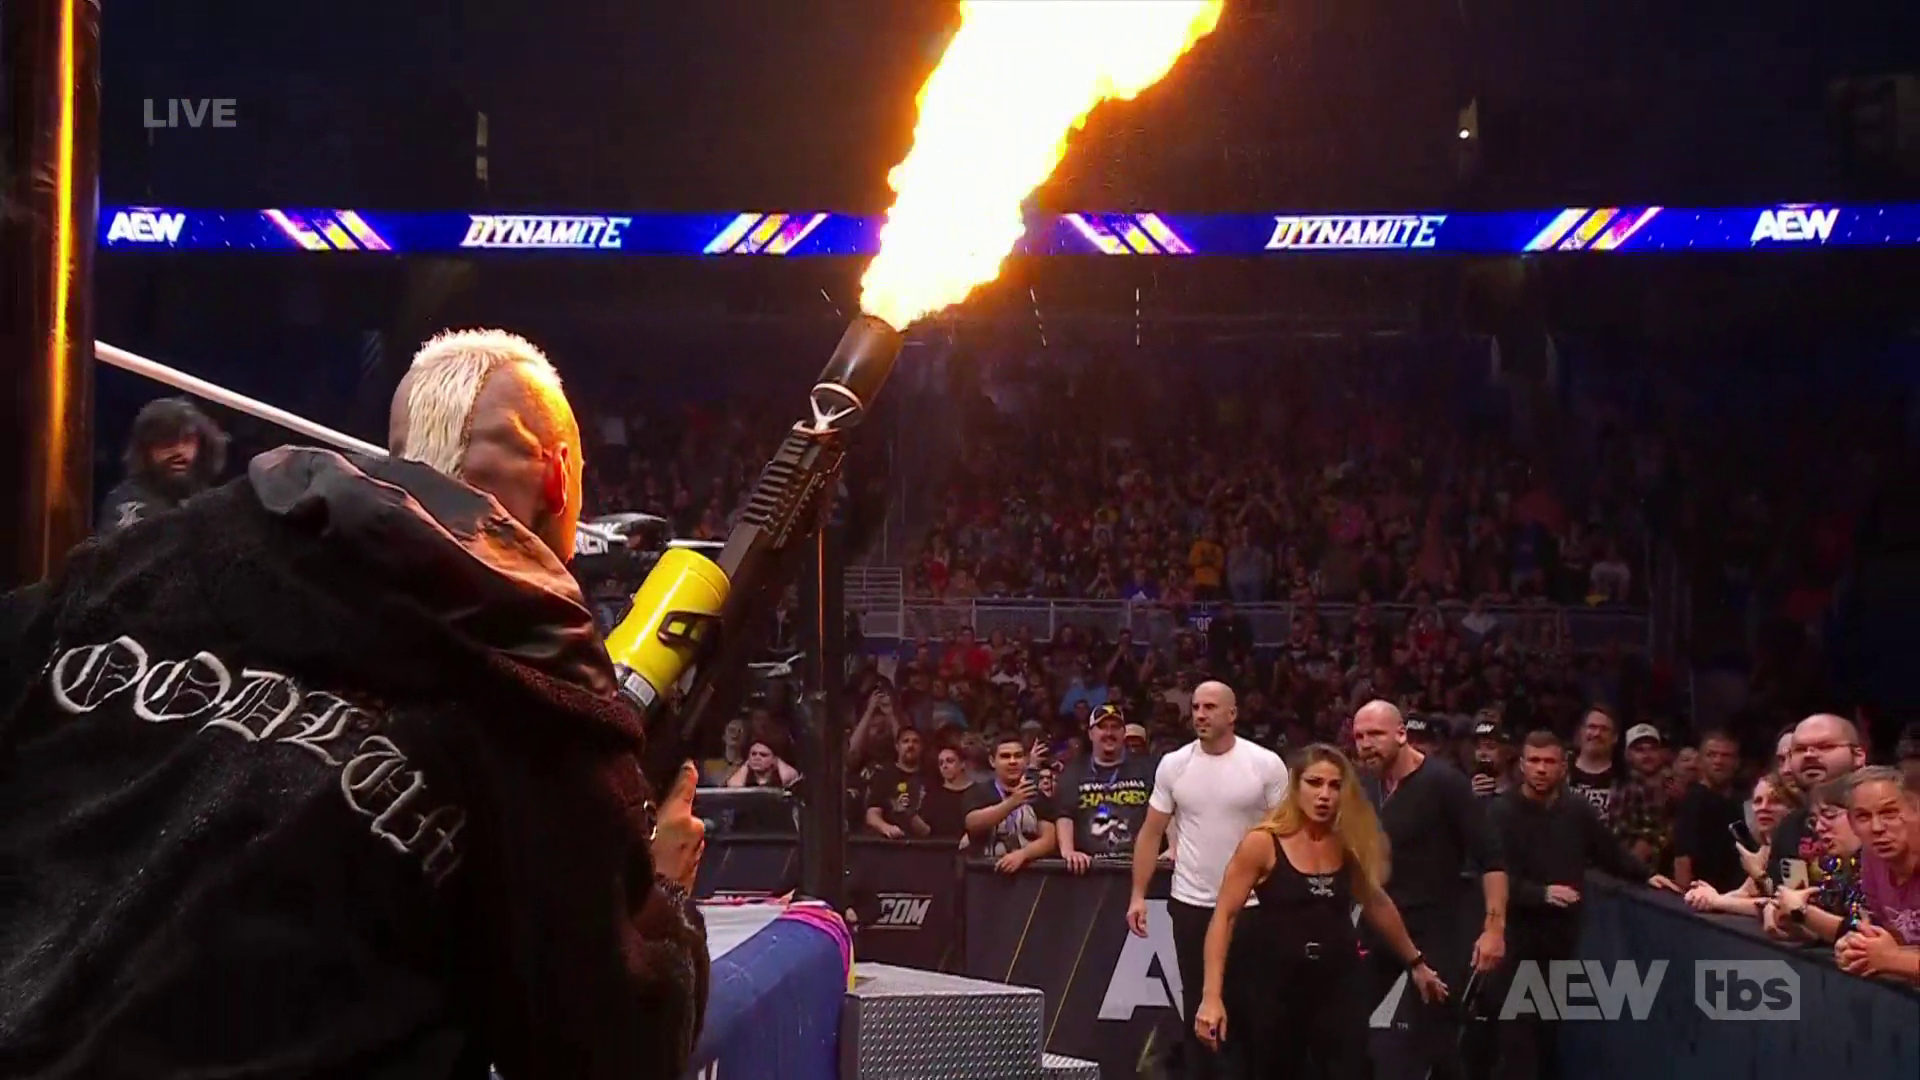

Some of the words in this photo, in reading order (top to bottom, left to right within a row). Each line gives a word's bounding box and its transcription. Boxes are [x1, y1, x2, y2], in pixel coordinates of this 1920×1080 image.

[107, 211, 187, 242] AEW
[459, 214, 633, 248] DYNAMITE
[1264, 214, 1448, 249] DYNAMITE
[1750, 208, 1841, 242] AEW
